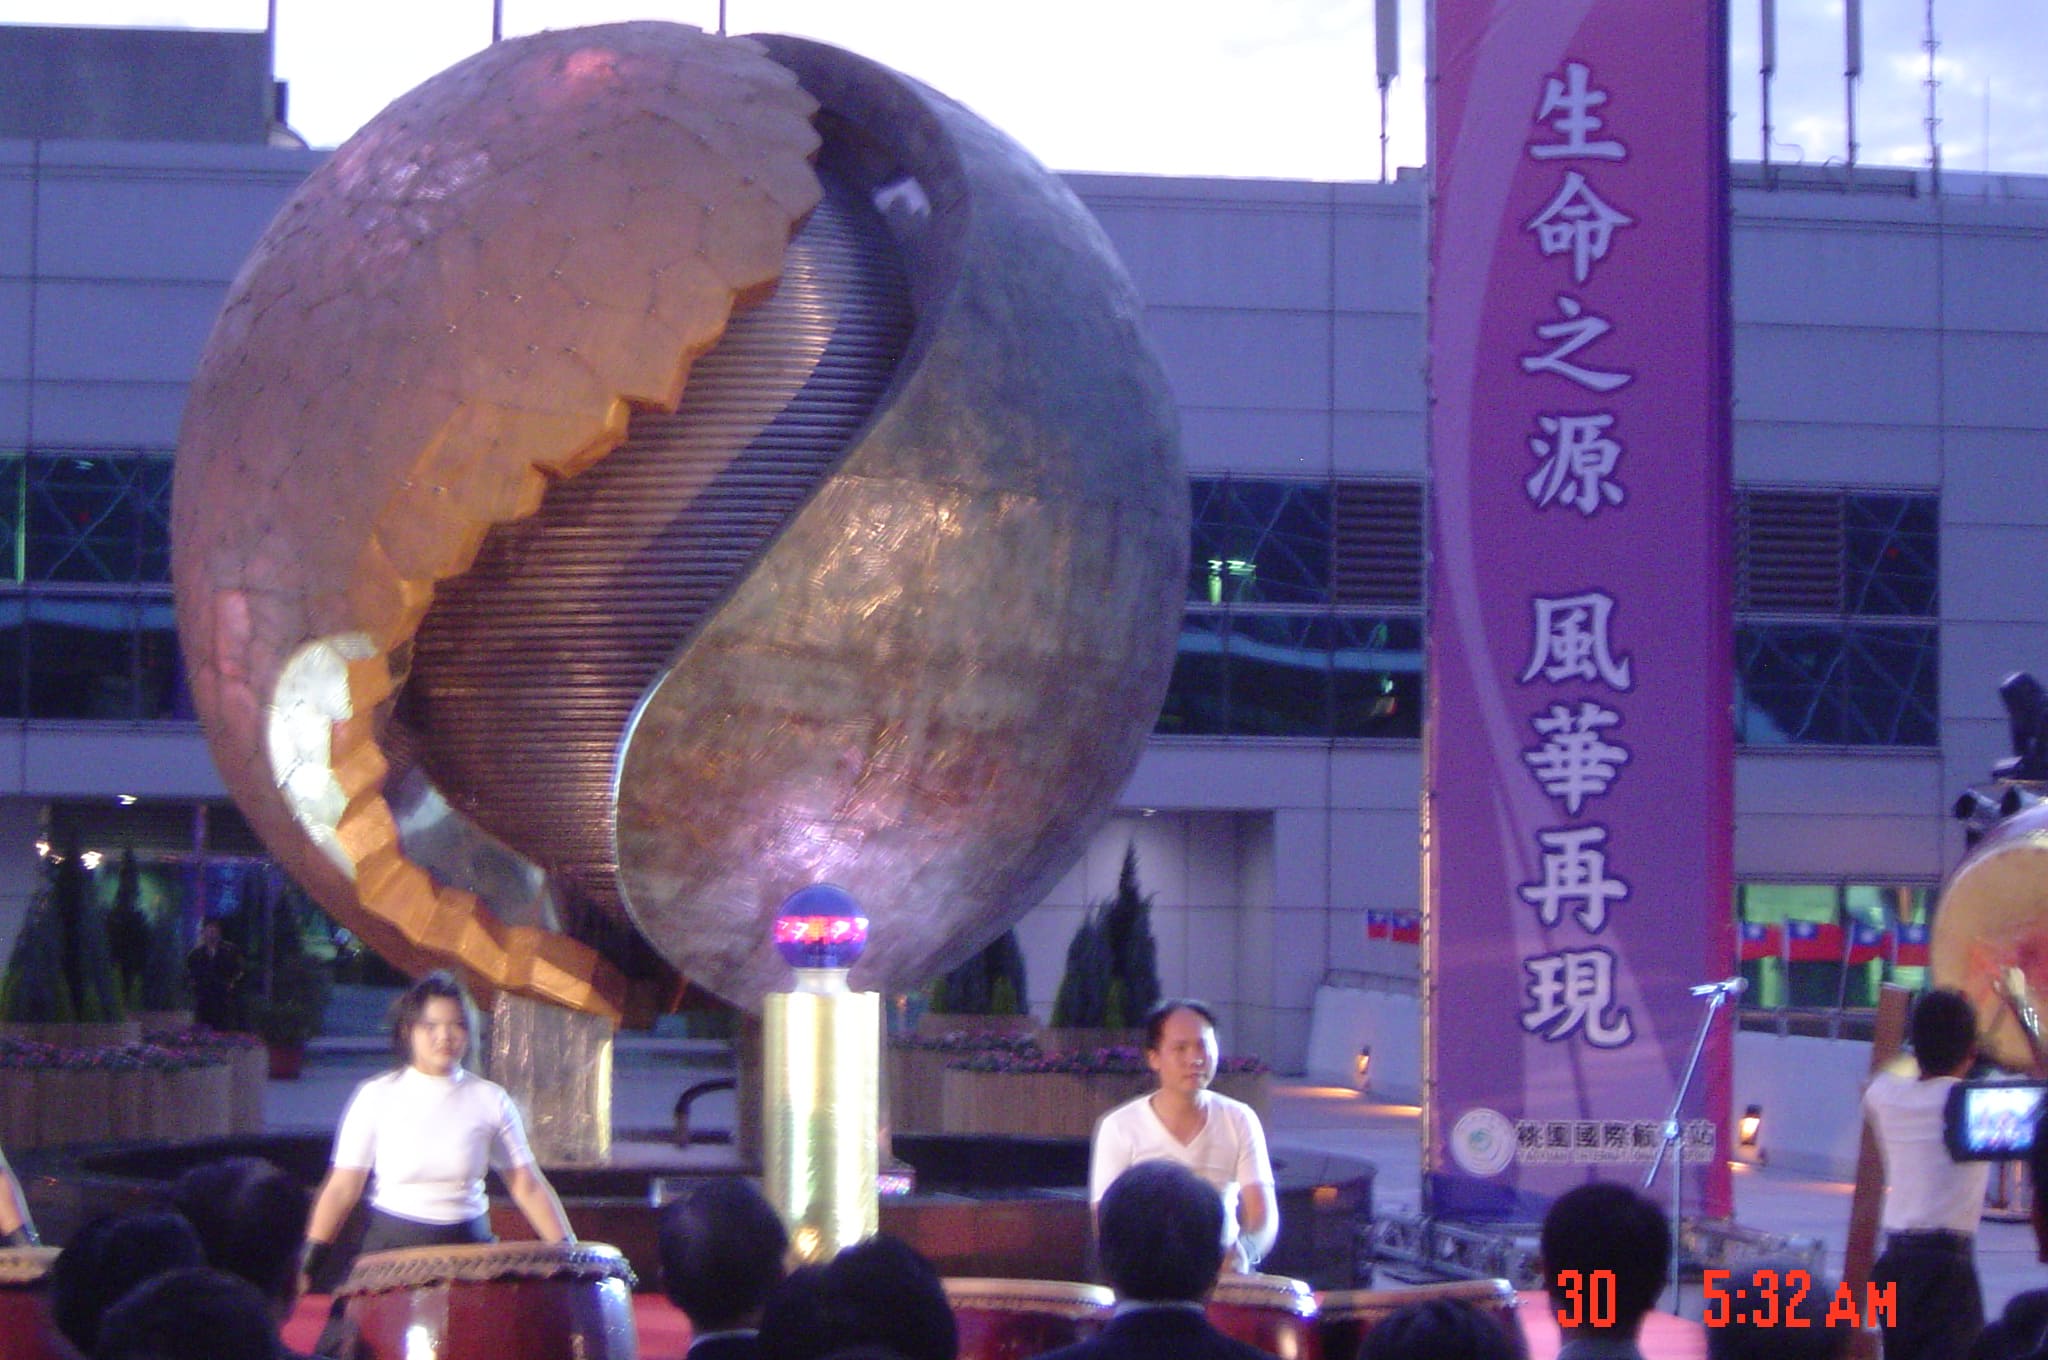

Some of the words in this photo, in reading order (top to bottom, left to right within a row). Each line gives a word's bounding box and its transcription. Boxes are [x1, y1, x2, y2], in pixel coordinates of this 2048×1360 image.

[1521, 62, 1636, 515] 生命之源
[1518, 592, 1634, 1049] 風華再現
[1517, 1121, 1715, 1149] 桃園國際航站
